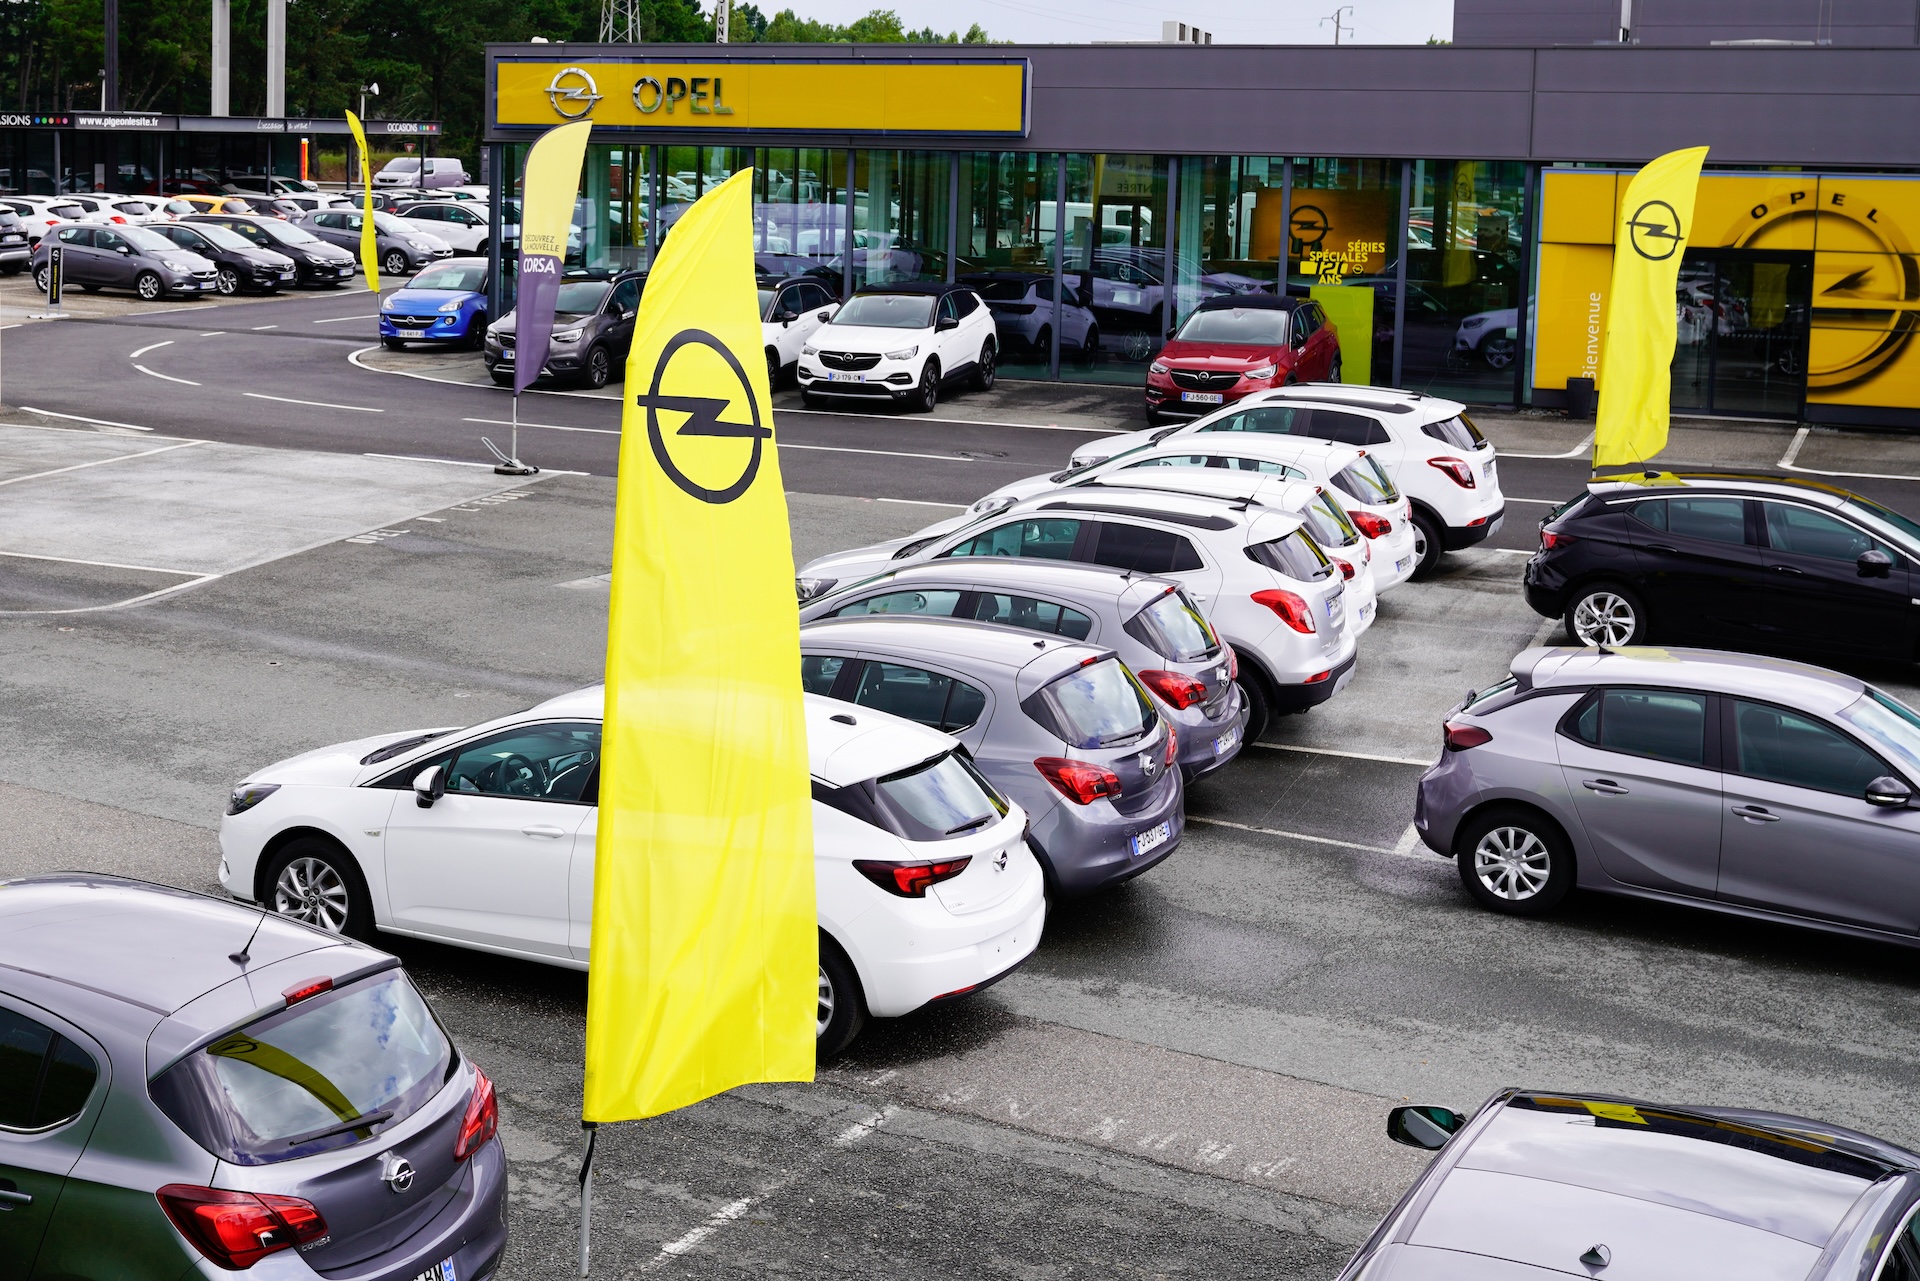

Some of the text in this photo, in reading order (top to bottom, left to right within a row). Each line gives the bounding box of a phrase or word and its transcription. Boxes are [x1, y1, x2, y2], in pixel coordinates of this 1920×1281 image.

[632, 76, 734, 114] OPEL
[0, 114, 31, 126] SIONS
[79, 116, 159, 128] www.pigeonlesite.fr
[387, 122, 418, 133] OCCASIONS
[1751, 191, 1878, 224] OPEL
[525, 233, 555, 243] DÉCOUVREZ
[530, 243, 560, 252] NOUVELLE
[1347, 239, 1385, 253] SÉRIES
[1309, 249, 1368, 263] SPÉCIALES
[523, 257, 556, 274] CORSA
[1318, 275, 1342, 285] ANS
[1582, 292, 1601, 380] Bienvenue
